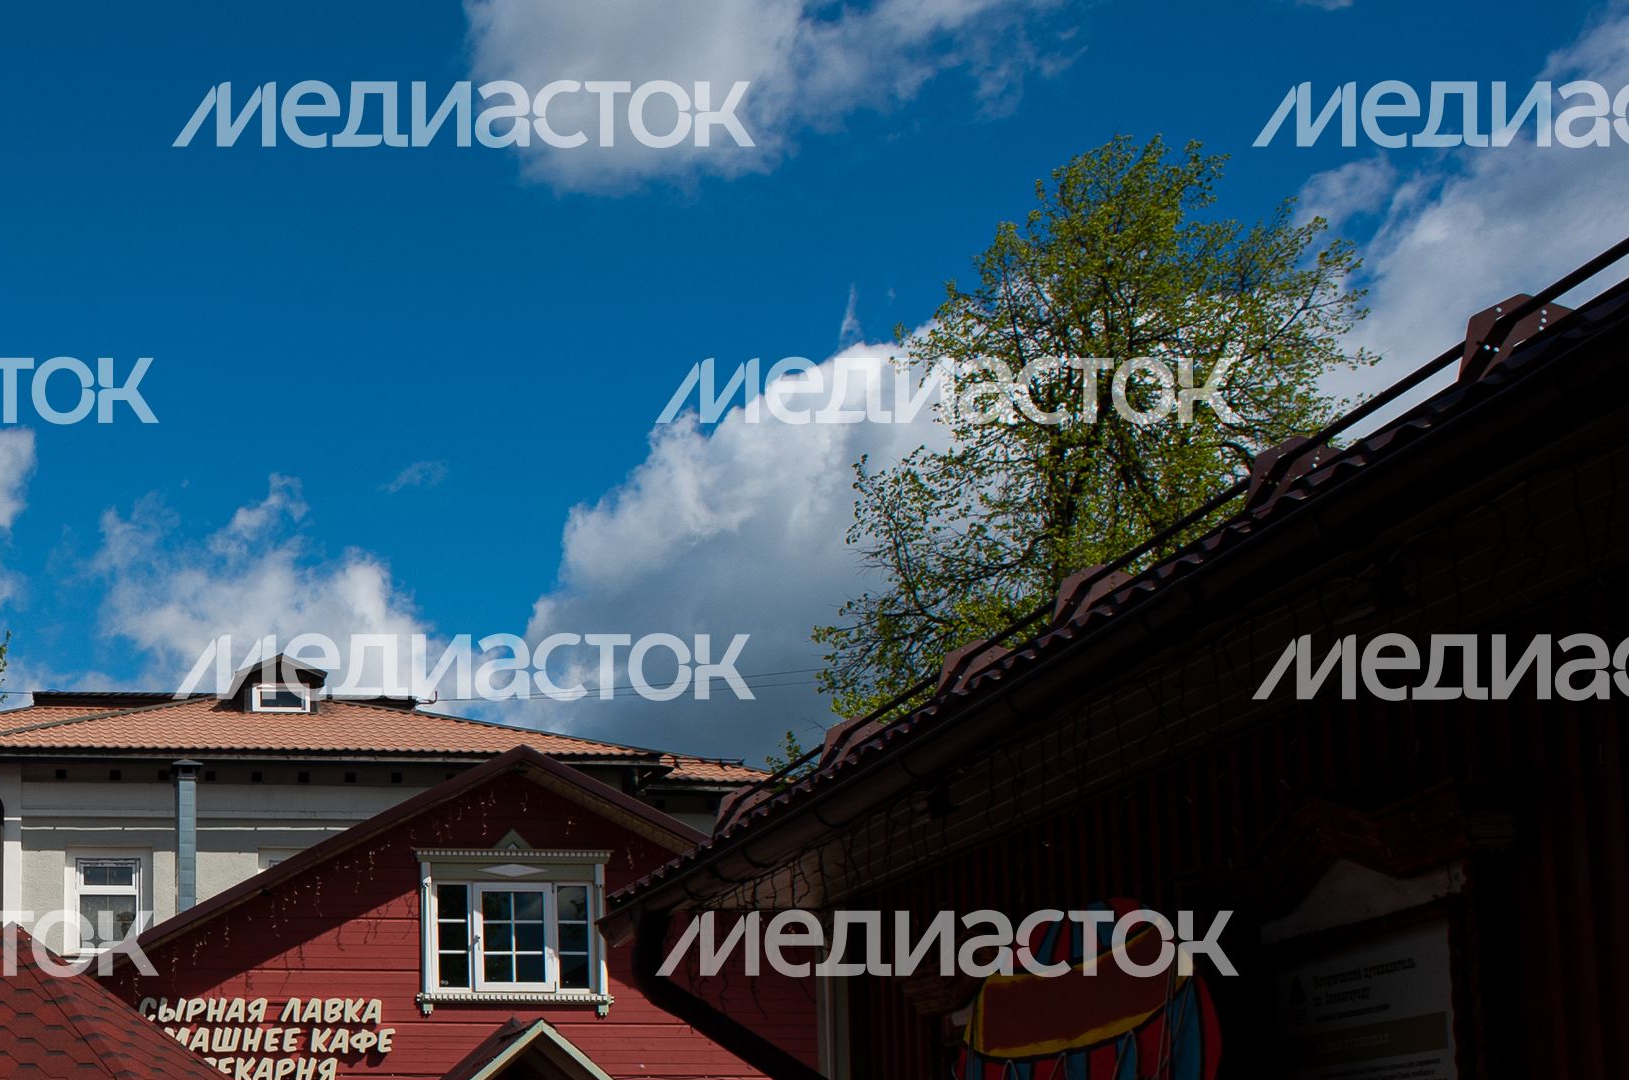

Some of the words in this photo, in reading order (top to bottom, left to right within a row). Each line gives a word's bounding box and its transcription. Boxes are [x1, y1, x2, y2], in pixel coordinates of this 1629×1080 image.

[139, 997, 268, 1023] СЫРНАЯ
[281, 997, 382, 1024] ЛАВКА
[311, 1027, 396, 1053] КАФЕ
